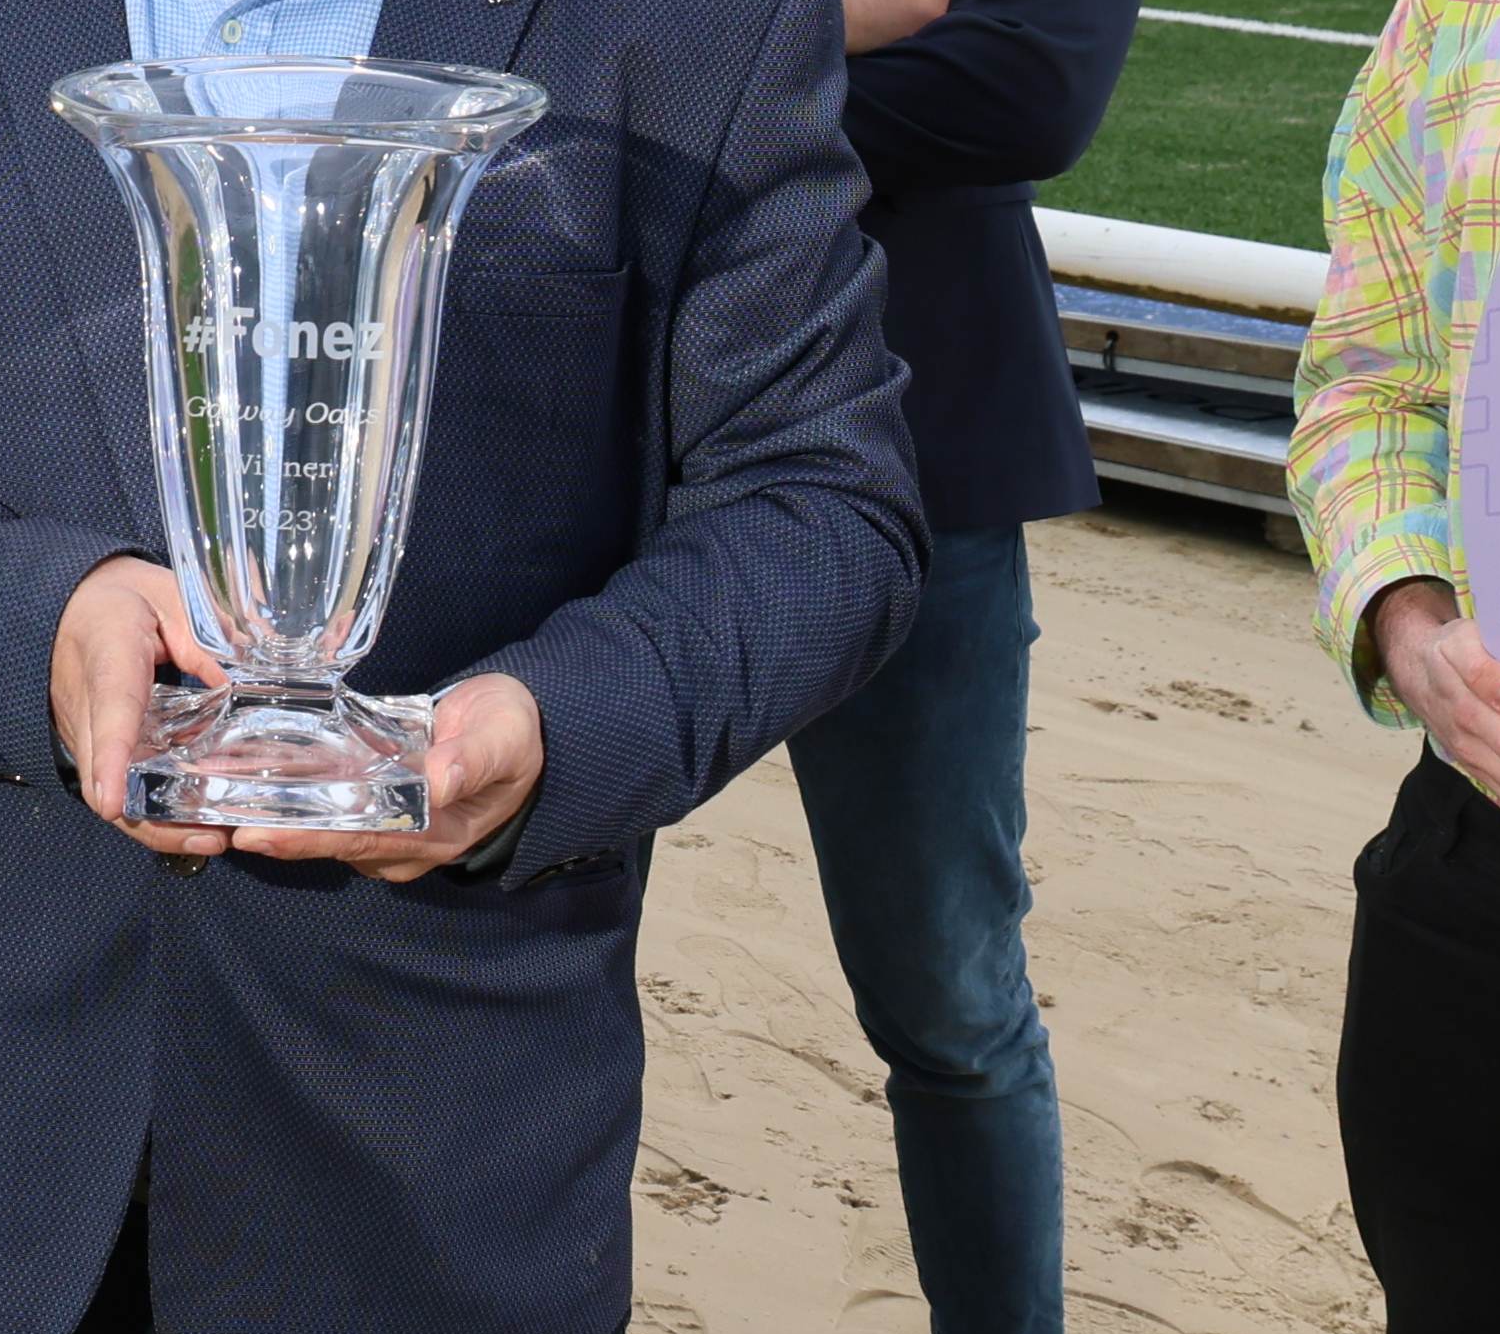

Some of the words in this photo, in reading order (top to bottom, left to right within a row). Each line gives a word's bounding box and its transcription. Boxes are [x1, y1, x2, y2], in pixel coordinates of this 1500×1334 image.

[183, 306, 386, 360] #Fonez
[186, 396, 298, 429] Gaway
[230, 453, 335, 478] Winer
[242, 509, 314, 531] 2023
